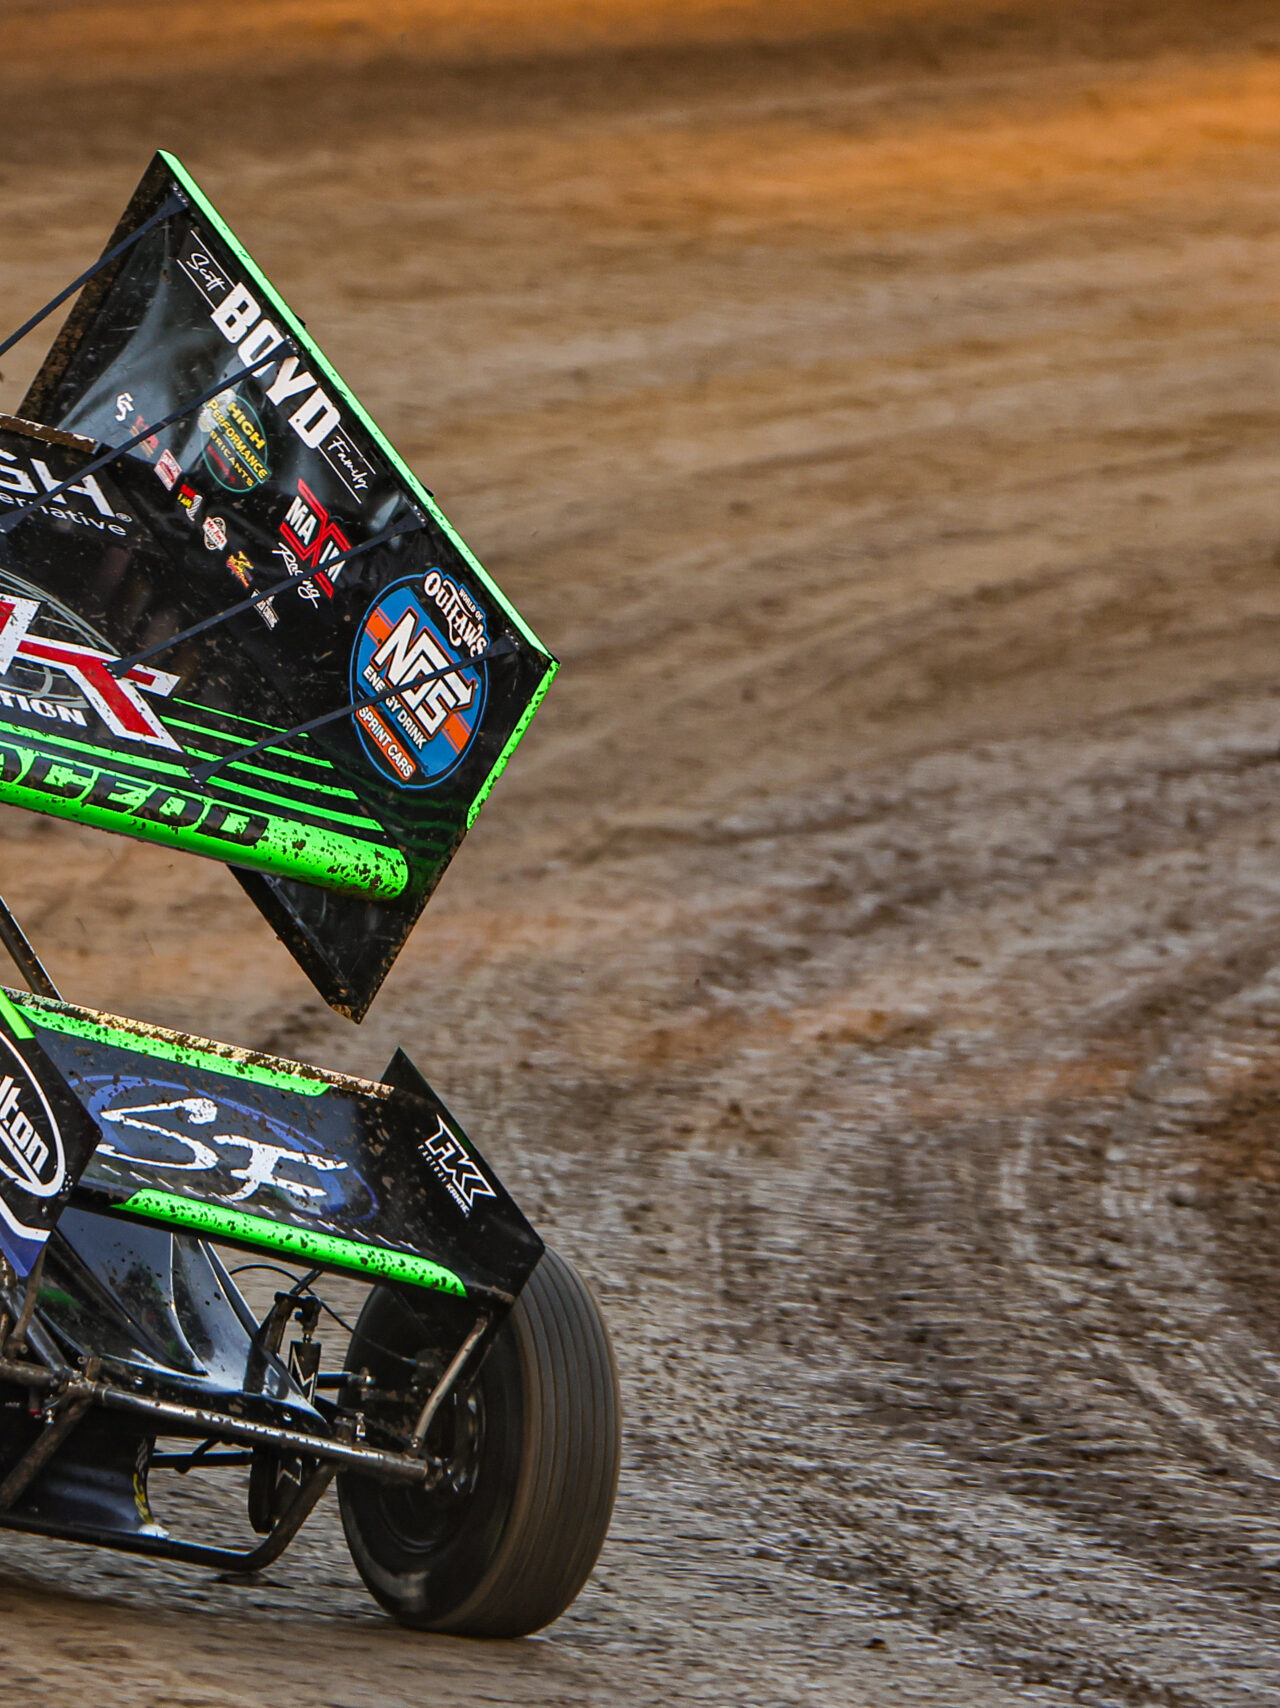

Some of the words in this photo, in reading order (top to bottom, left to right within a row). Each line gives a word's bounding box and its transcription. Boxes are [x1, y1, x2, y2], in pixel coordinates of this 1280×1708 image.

[186, 253, 226, 291] Scott
[210, 282, 341, 449] BOYD
[327, 435, 368, 489] Family
[206, 399, 268, 480] PERFORMANCE
[227, 402, 266, 450] HIGH
[458, 588, 477, 612] WORLD
[363, 665, 402, 715] ENEGY
[396, 710, 427, 749] DRINK
[372, 612, 476, 736] NOS
[358, 708, 391, 749] SPRINT
[388, 744, 414, 778] CARS
